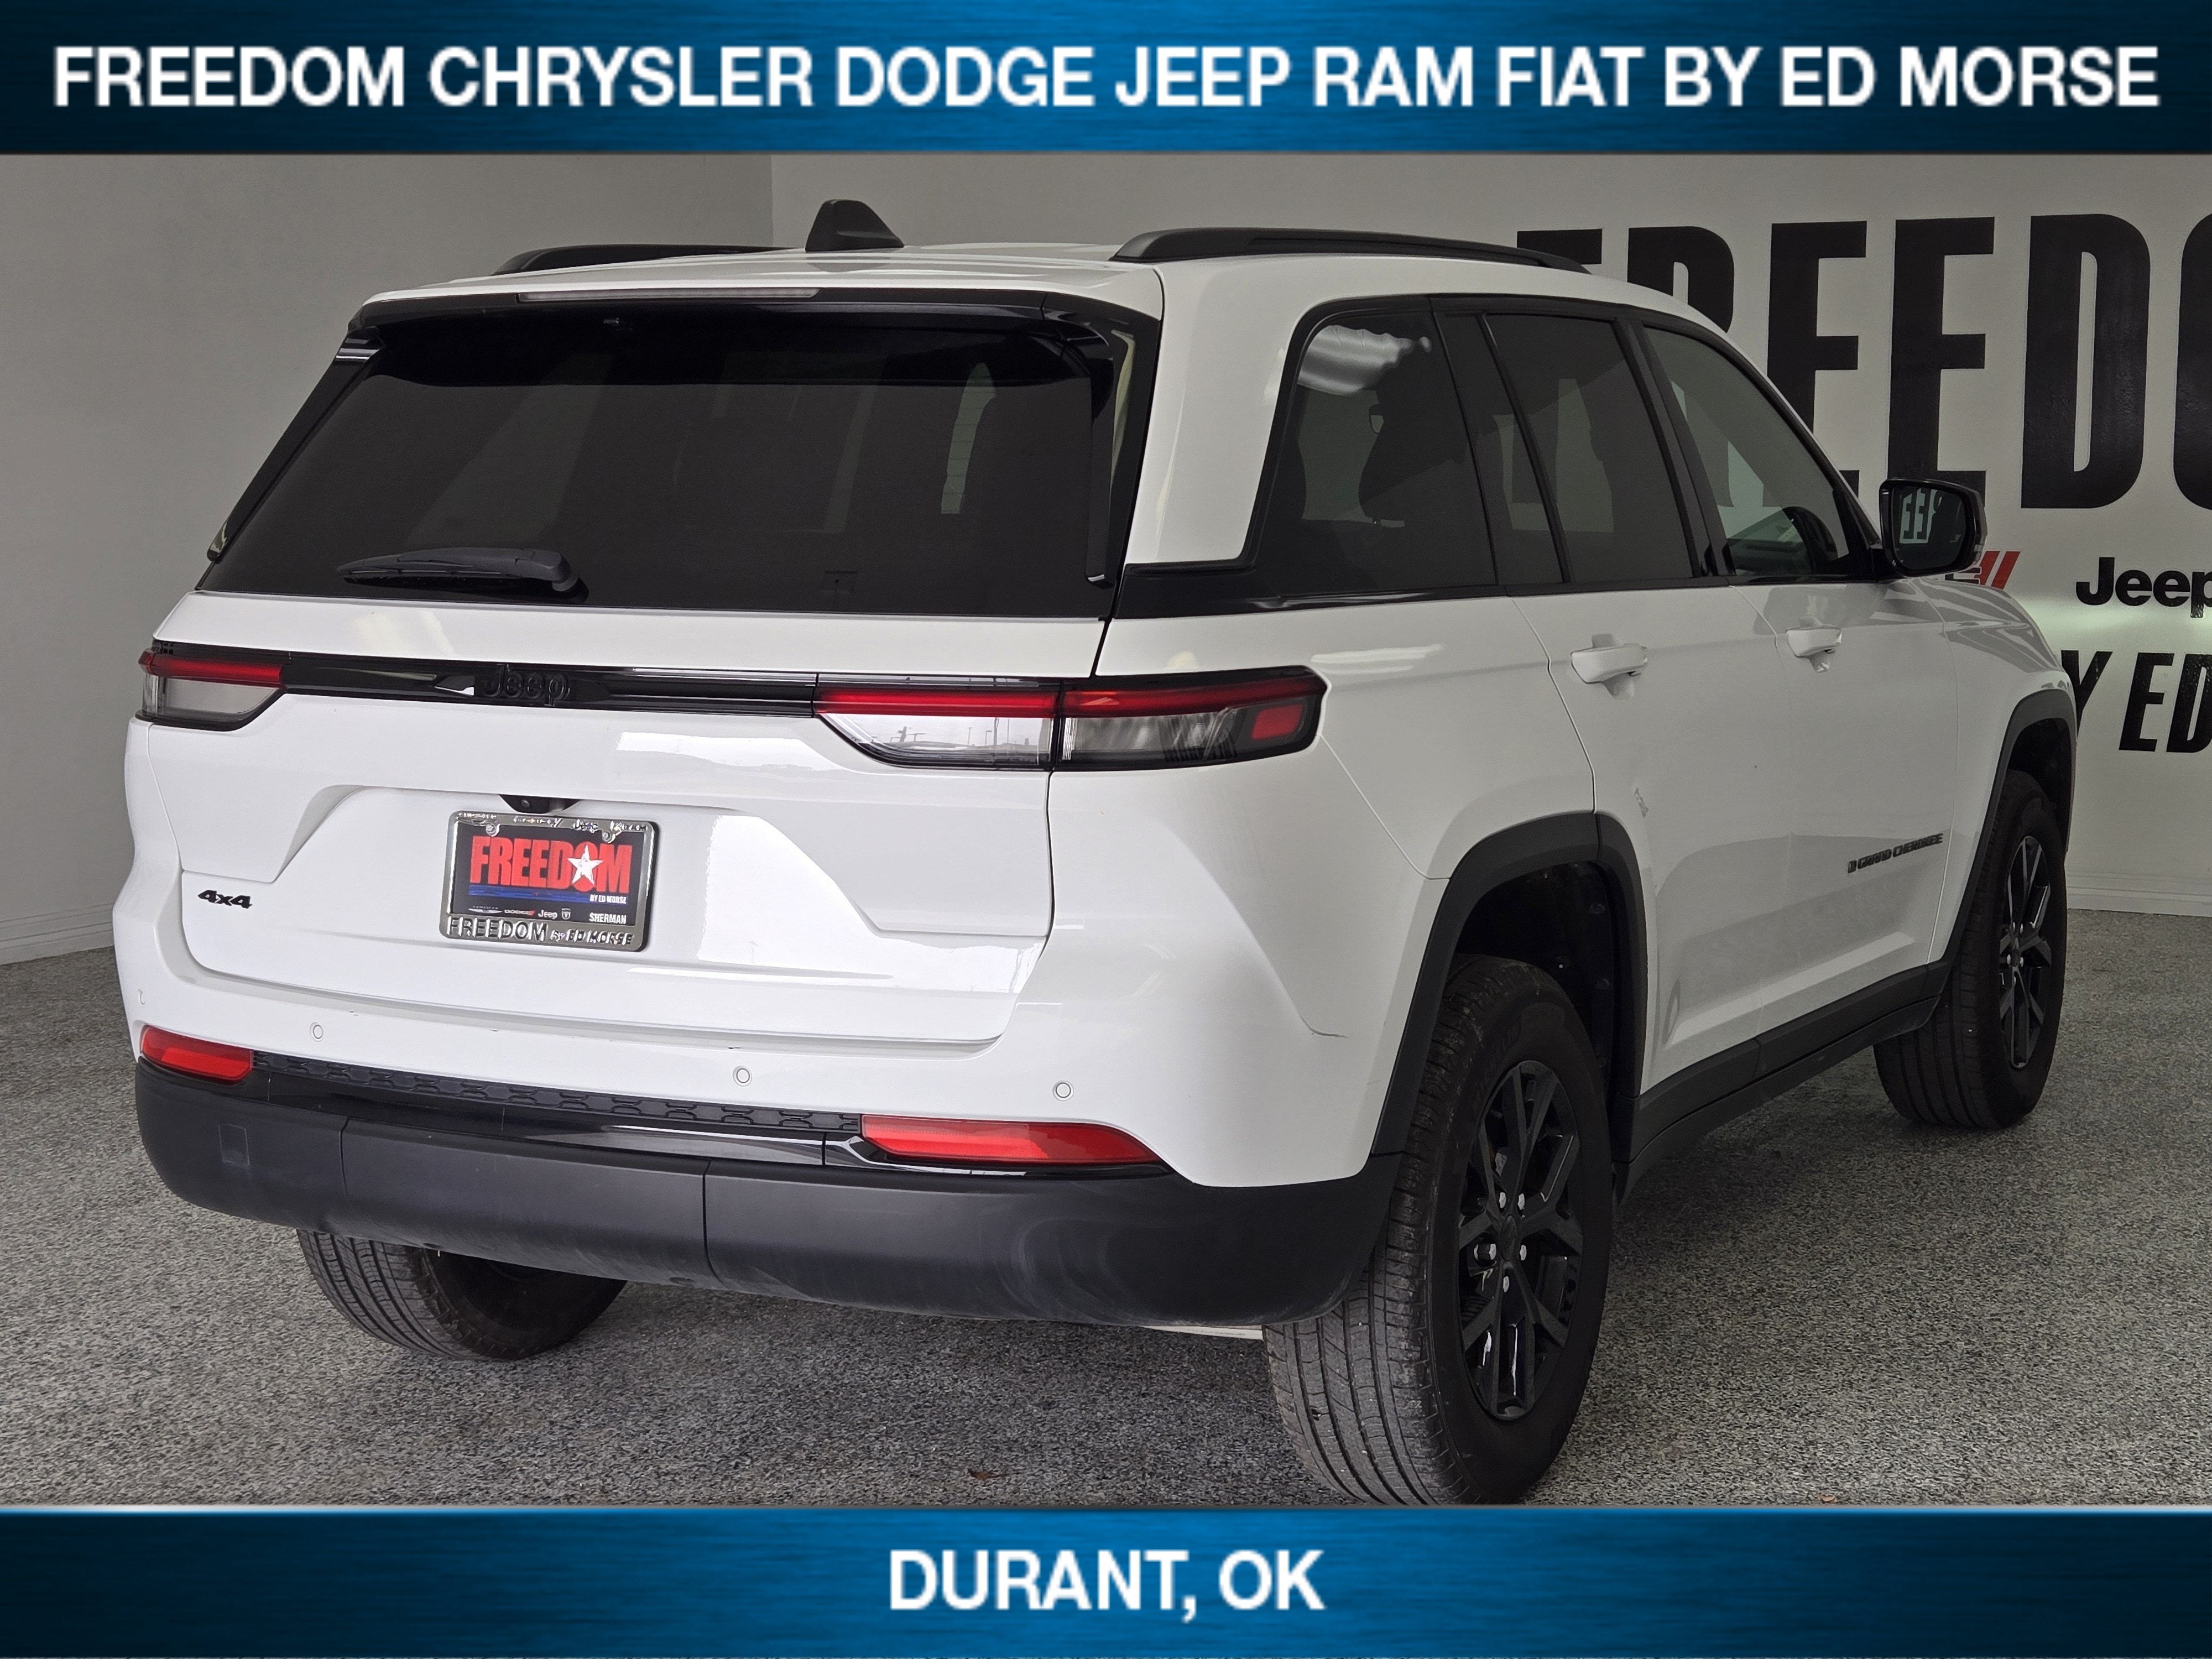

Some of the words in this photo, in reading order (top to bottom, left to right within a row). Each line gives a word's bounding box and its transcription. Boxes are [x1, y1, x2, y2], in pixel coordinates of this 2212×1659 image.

[479, 664, 571, 707] Jeep
[469, 835, 633, 894] FREEDOM
[589, 894, 598, 902] BY
[538, 909, 558, 920] Jeep
[589, 912, 627, 925] SHERMAN
[446, 916, 548, 942] FREEDOM
